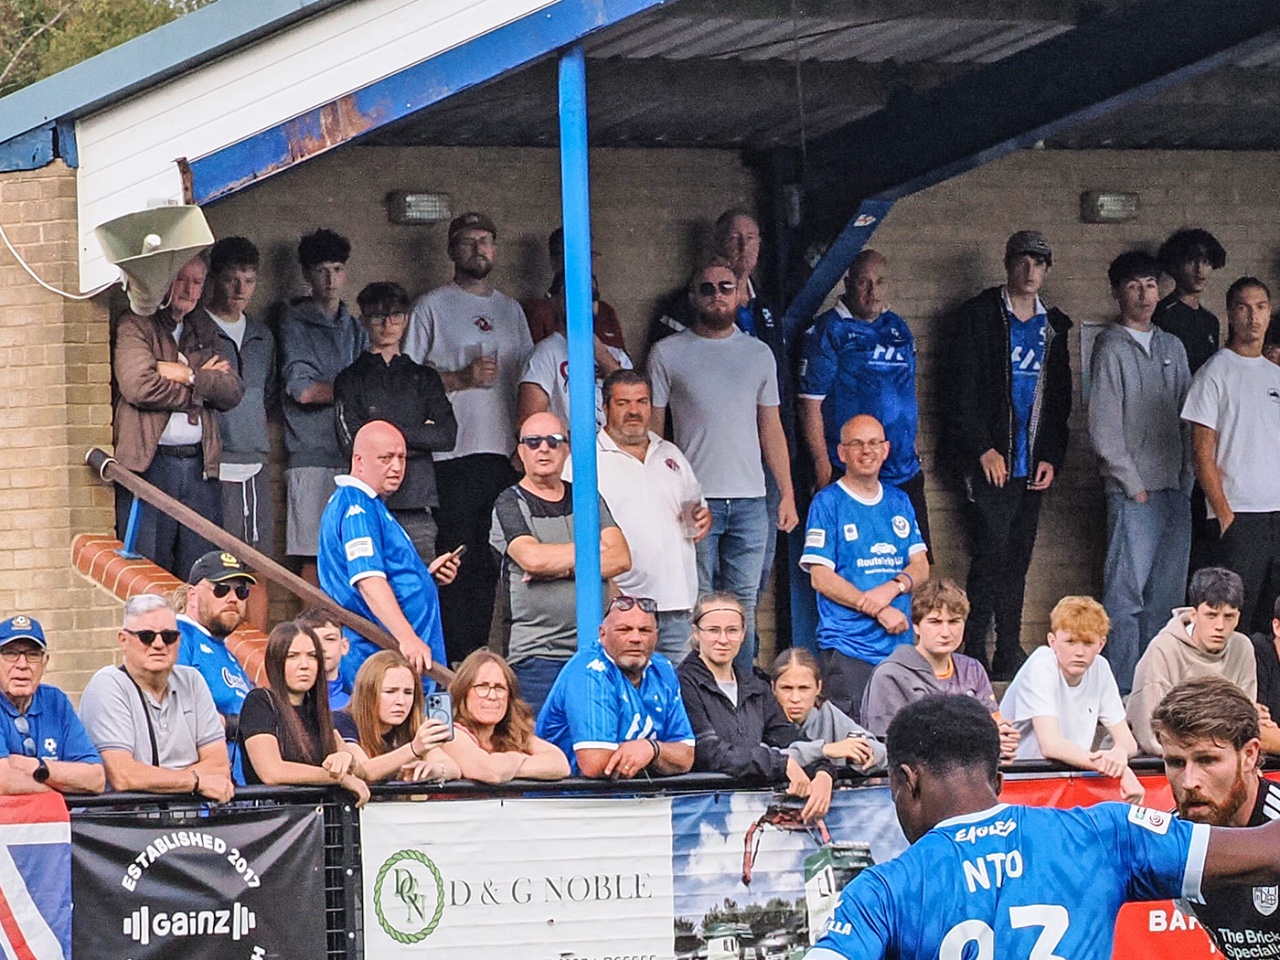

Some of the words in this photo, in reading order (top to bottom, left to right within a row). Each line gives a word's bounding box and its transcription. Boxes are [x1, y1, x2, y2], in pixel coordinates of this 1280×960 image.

[955, 818, 1017, 844] EAGLES
[121, 832, 227, 892] ESTABLISHED
[227, 849, 261, 888] 2017
[962, 850, 1023, 893] NTO
[450, 879, 472, 906] D
[480, 878, 501, 905] &
[511, 877, 532, 905] G
[544, 873, 653, 903] NOBLE
[1217, 928, 1244, 944] The
